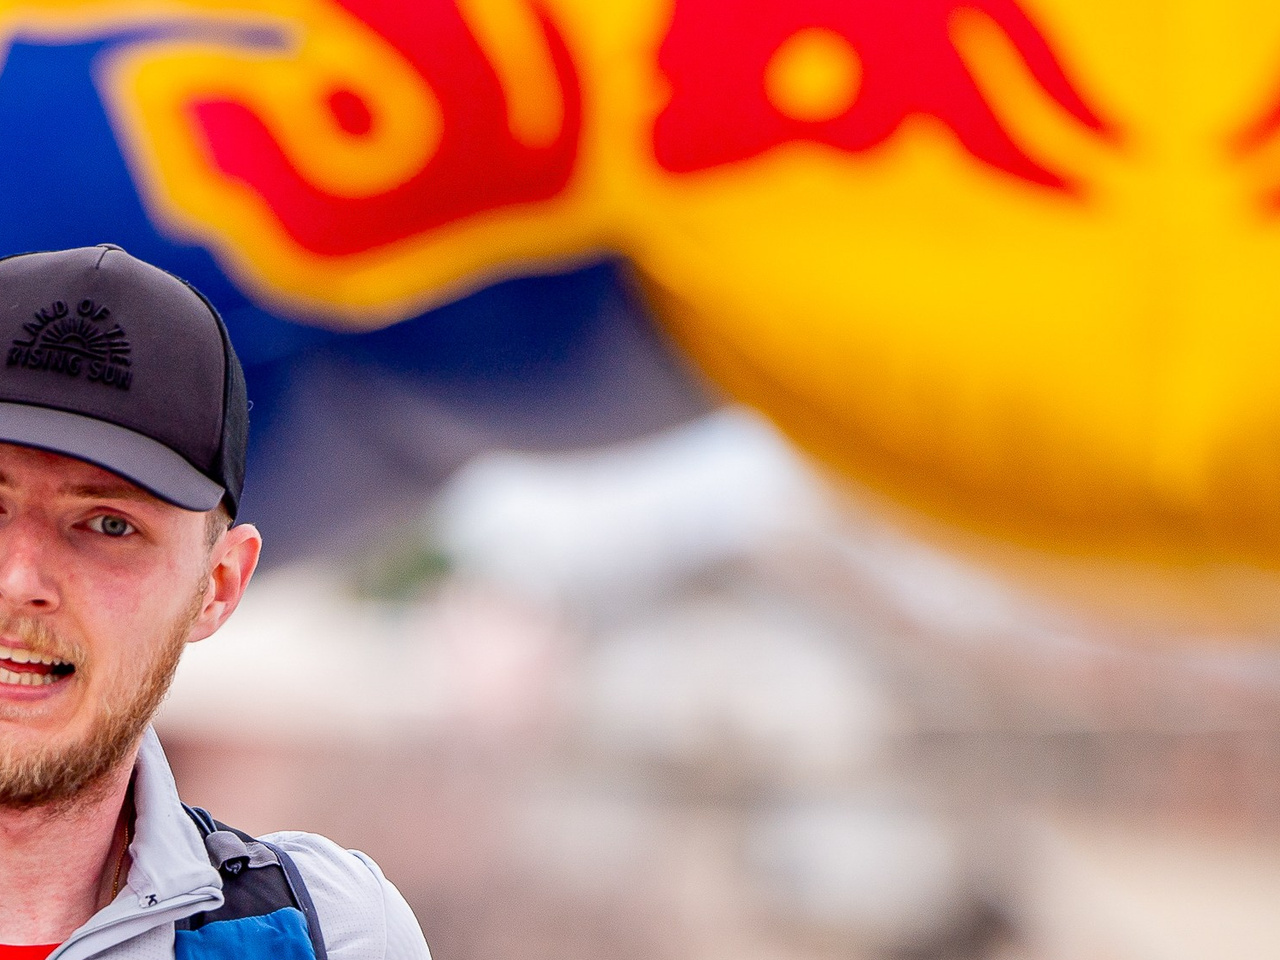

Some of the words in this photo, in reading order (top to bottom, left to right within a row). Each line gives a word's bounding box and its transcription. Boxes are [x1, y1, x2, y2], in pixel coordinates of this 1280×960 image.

[12, 300, 69, 347] LAND
[77, 299, 110, 320] OF
[6, 346, 82, 376] RISING
[87, 361, 133, 391] SUN
